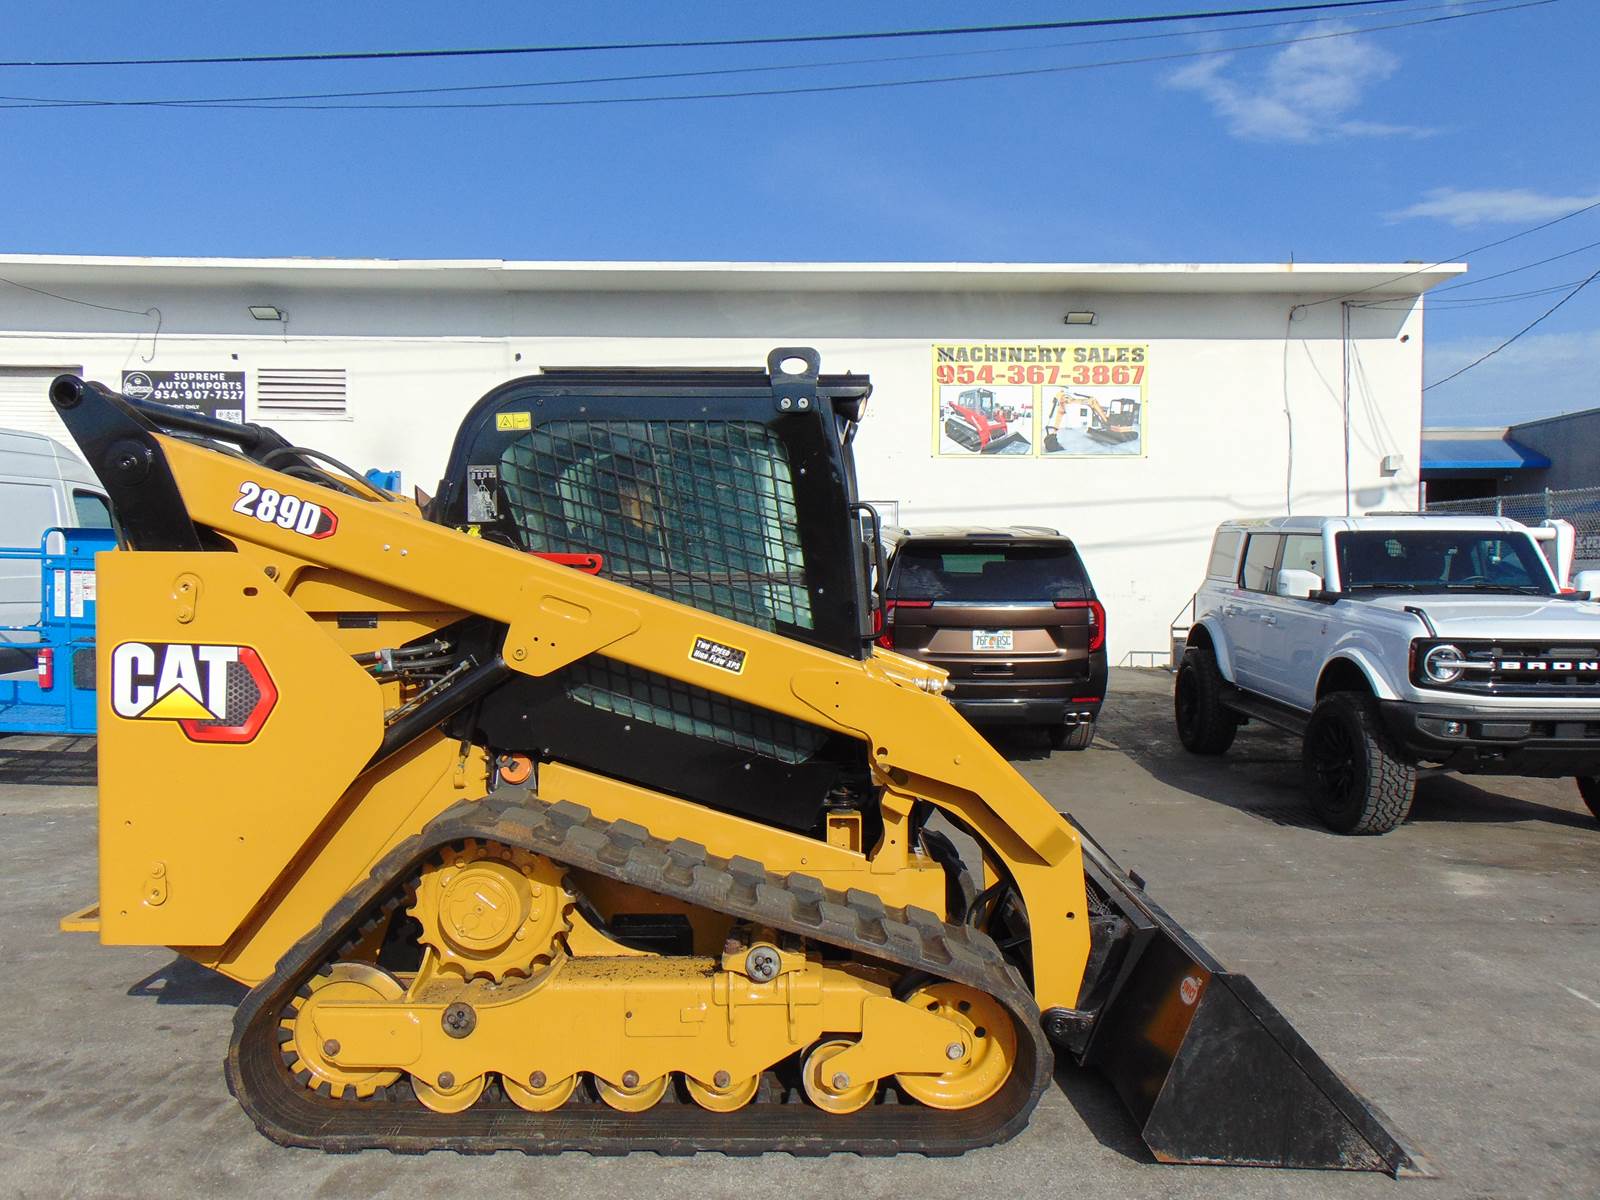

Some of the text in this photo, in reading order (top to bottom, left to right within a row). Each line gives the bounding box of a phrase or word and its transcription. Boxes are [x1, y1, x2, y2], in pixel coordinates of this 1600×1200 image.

[937, 347, 1145, 362] MACHINERY SALES
[936, 365, 1145, 384] 954-367-3867
[154, 390, 244, 399] 954-907-7527
[233, 481, 321, 535] 289D
[726, 660, 741, 670] XPS
[114, 642, 239, 720] CAT
